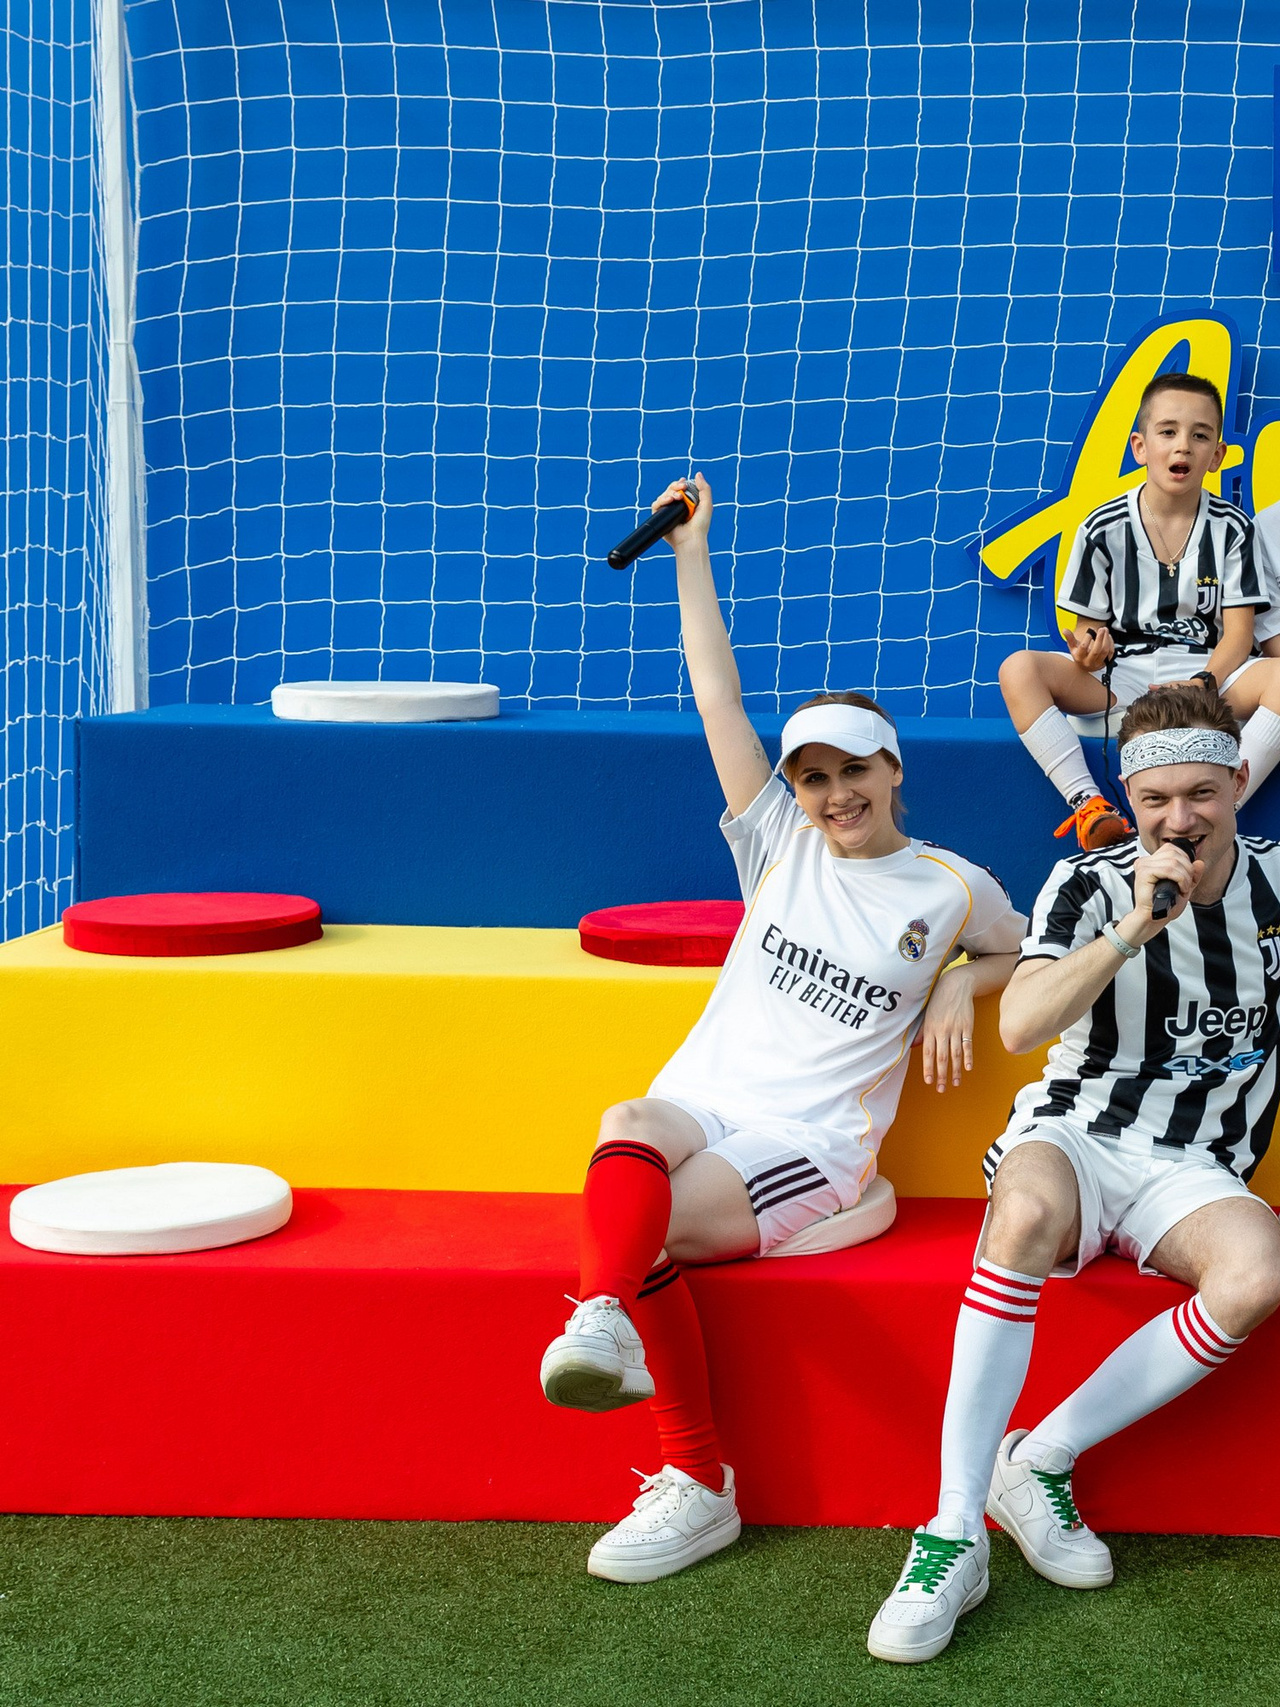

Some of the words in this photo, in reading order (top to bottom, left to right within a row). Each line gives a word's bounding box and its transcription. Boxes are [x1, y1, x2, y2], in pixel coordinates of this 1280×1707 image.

[761, 922, 902, 1013] Emirates
[768, 965, 803, 994] FLY
[798, 981, 870, 1030] BETTER
[1164, 998, 1269, 1041] Jeep
